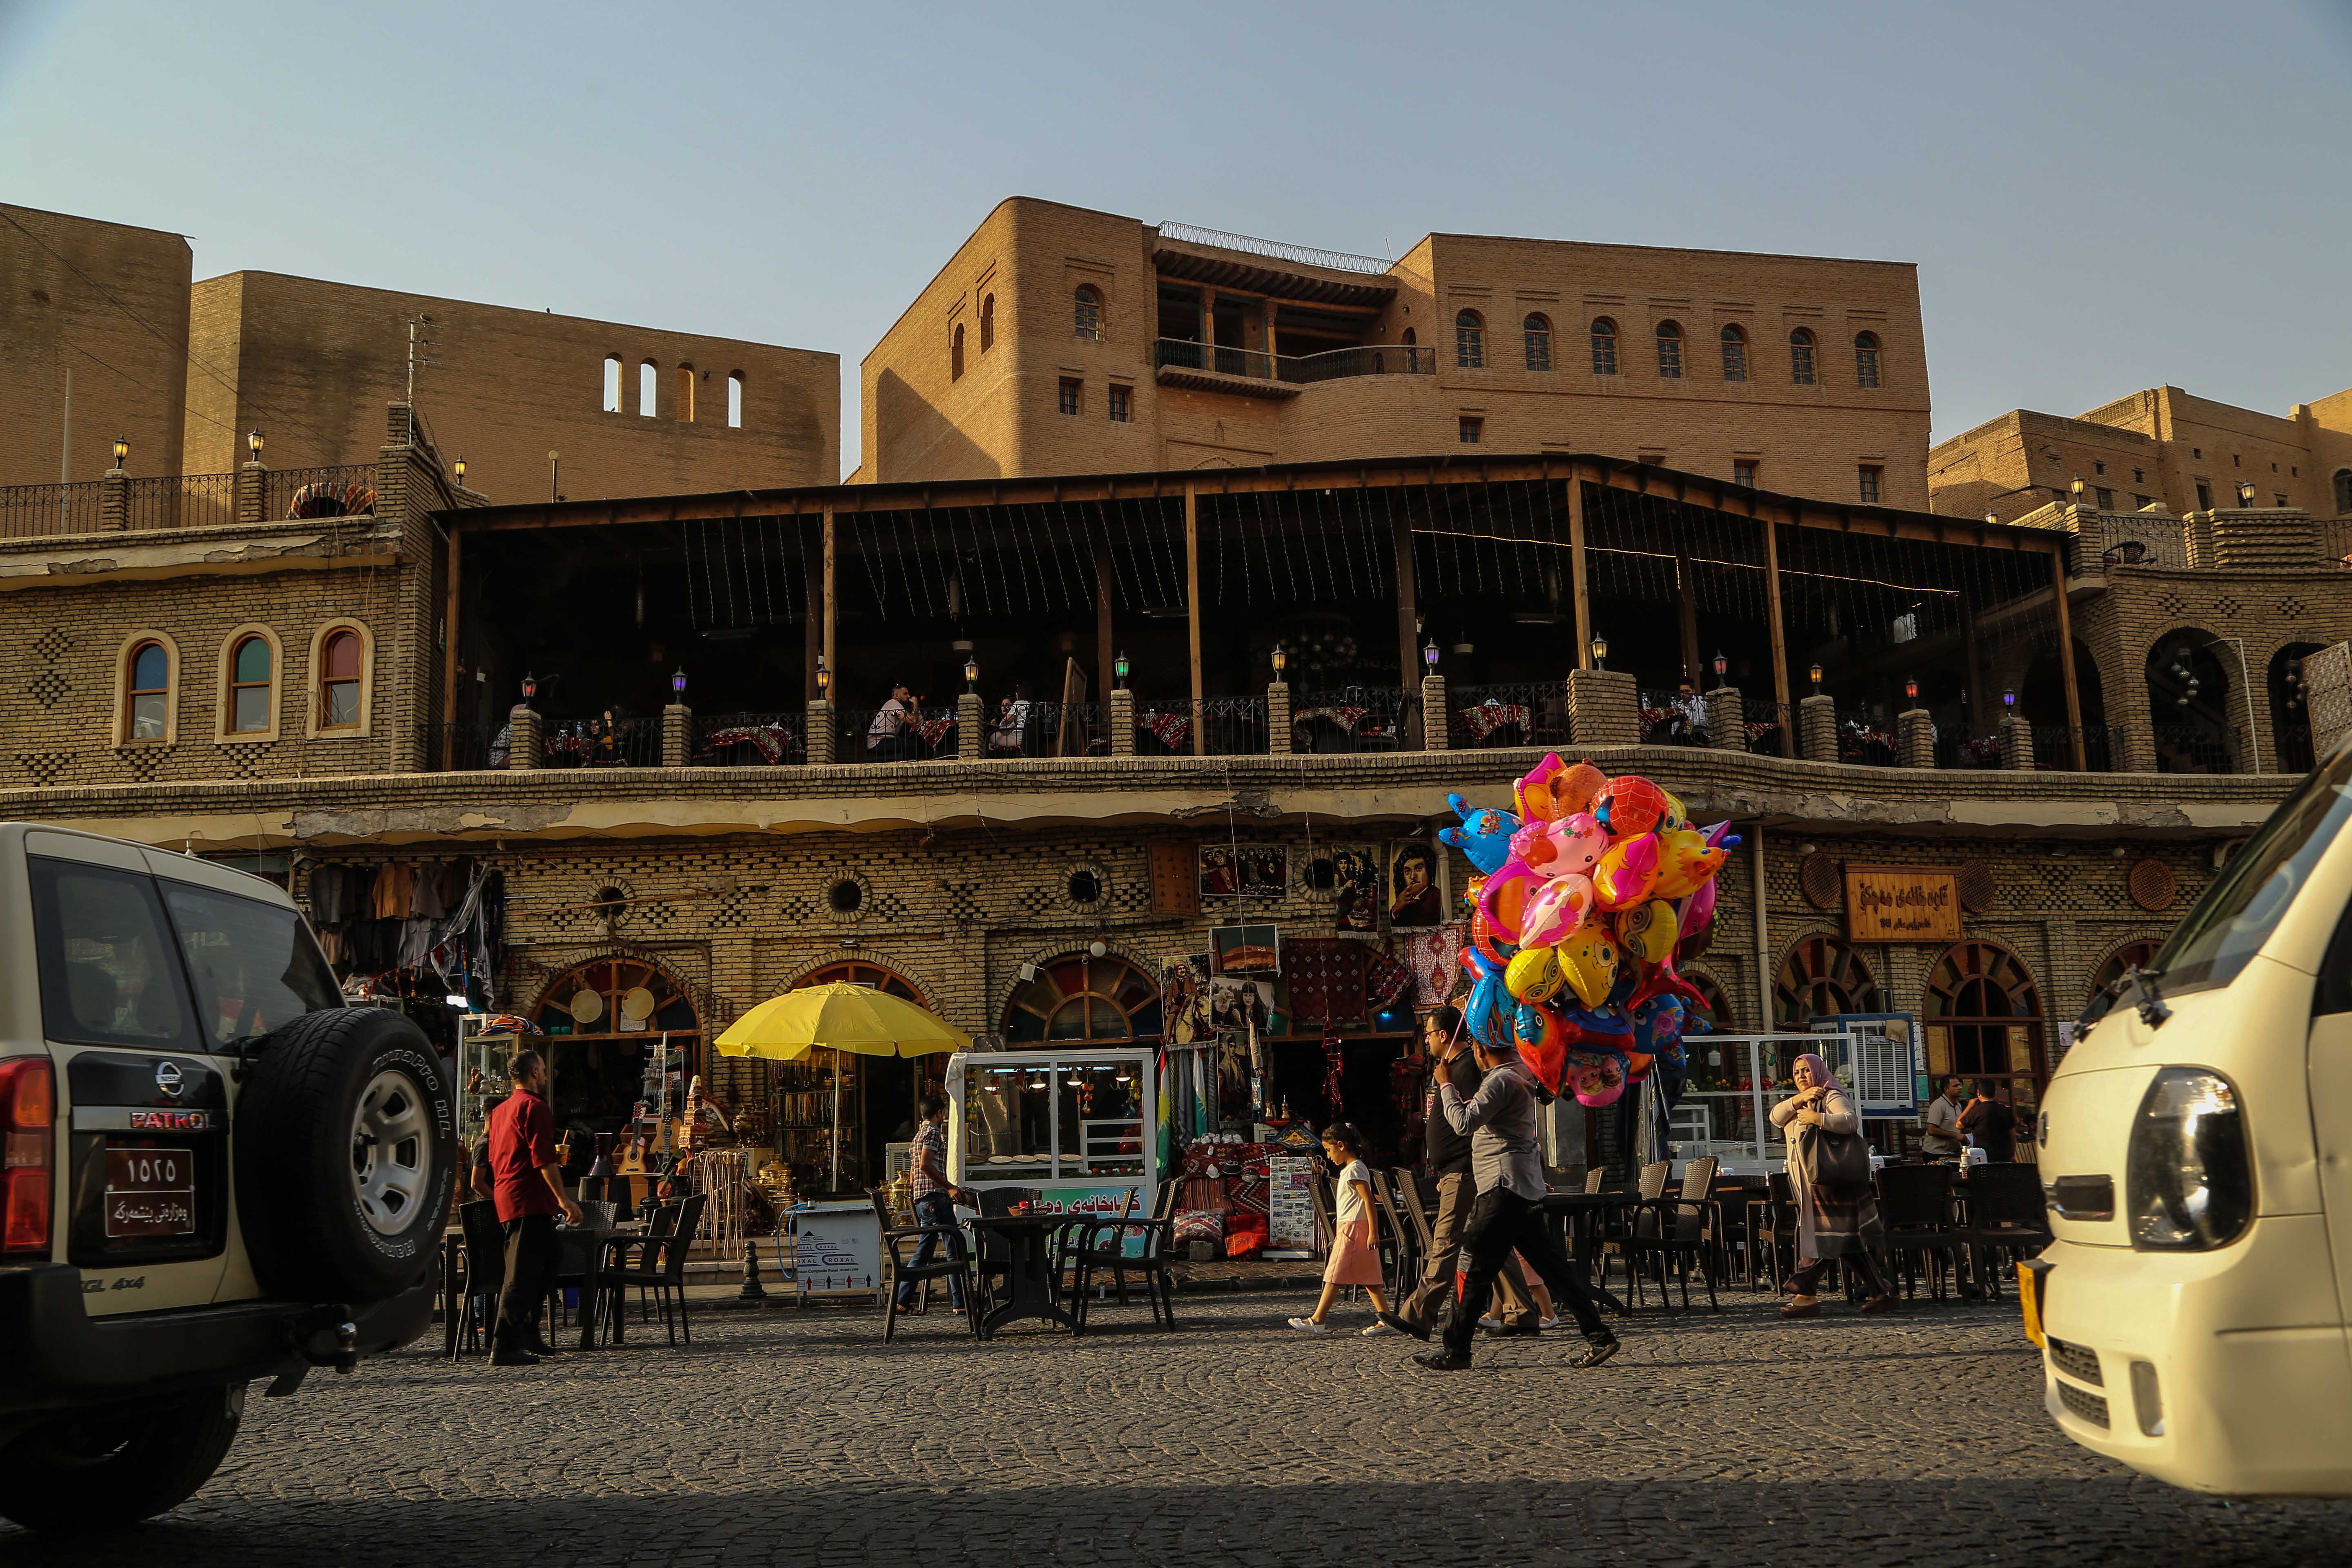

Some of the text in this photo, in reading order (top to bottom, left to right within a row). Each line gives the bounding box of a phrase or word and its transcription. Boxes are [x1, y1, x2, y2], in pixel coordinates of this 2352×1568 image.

[131, 1111, 216, 1129] PATROL
[127, 1159, 176, 1182] ١٥٢٥
[111, 1276, 145, 1290] 4x4
